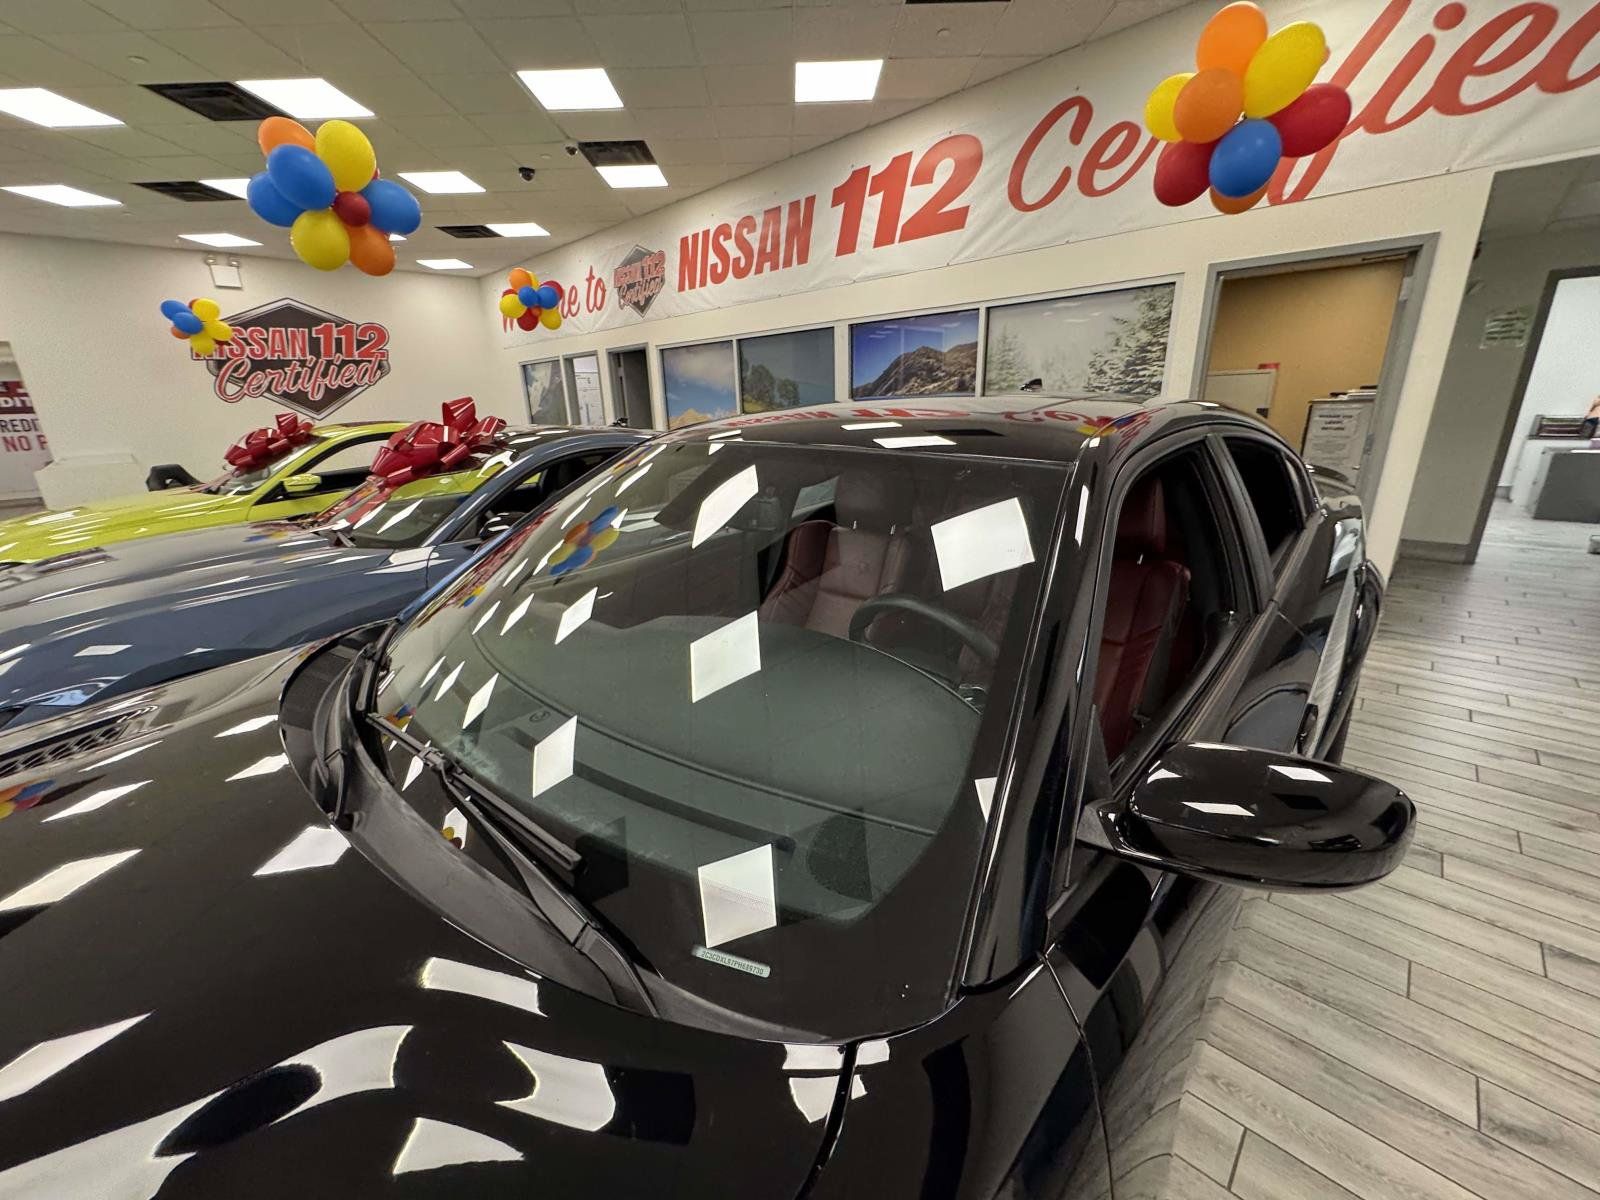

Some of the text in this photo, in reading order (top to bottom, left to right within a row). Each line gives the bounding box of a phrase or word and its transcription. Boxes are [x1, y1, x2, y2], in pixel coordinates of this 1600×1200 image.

[586, 265, 607, 313] to
[677, 195, 816, 293] NISSAN
[831, 134, 983, 257] 112
[193, 322, 391, 360] SSAN 112
[215, 353, 382, 403] Certified
[3, 435, 32, 452] NO
